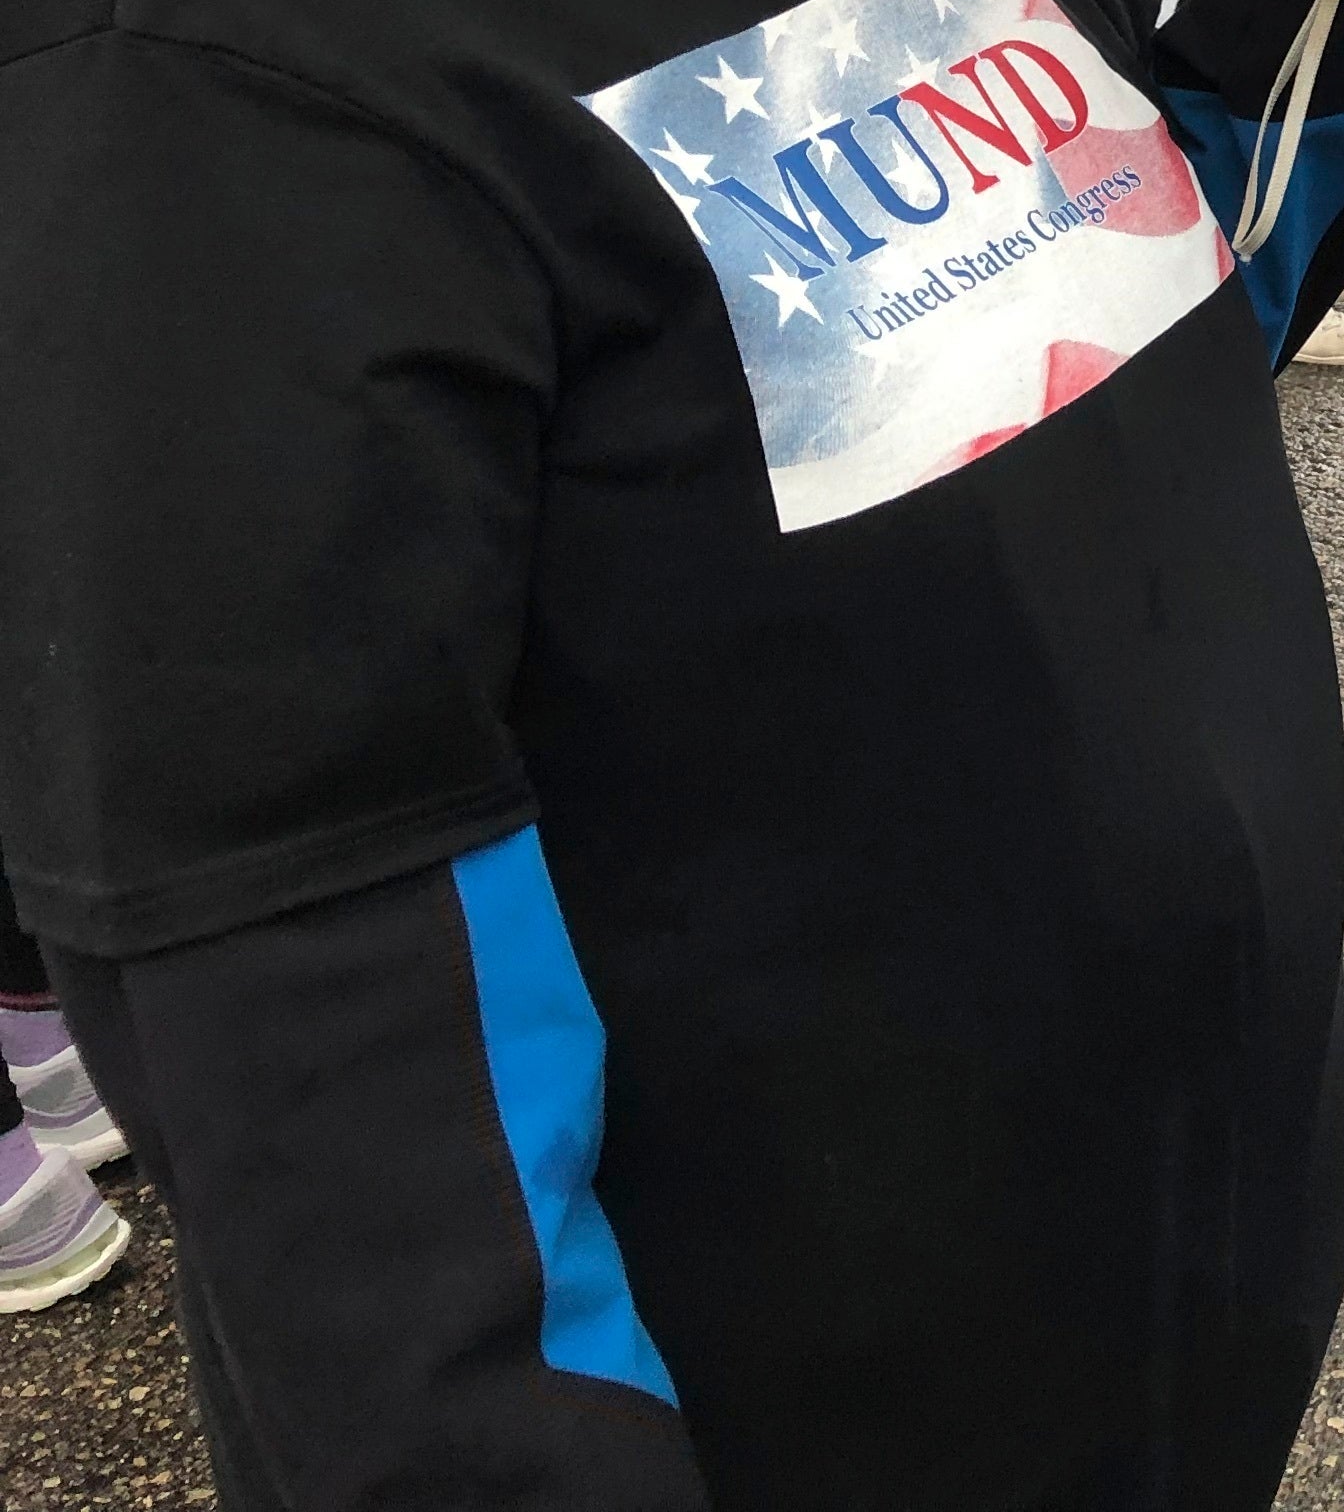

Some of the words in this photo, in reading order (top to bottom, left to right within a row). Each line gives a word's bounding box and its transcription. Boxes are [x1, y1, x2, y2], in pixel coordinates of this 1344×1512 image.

[706, 39, 1090, 281] MUND
[846, 267, 958, 341] United
[943, 239, 1037, 292] States
[1026, 164, 1142, 243] Congress
